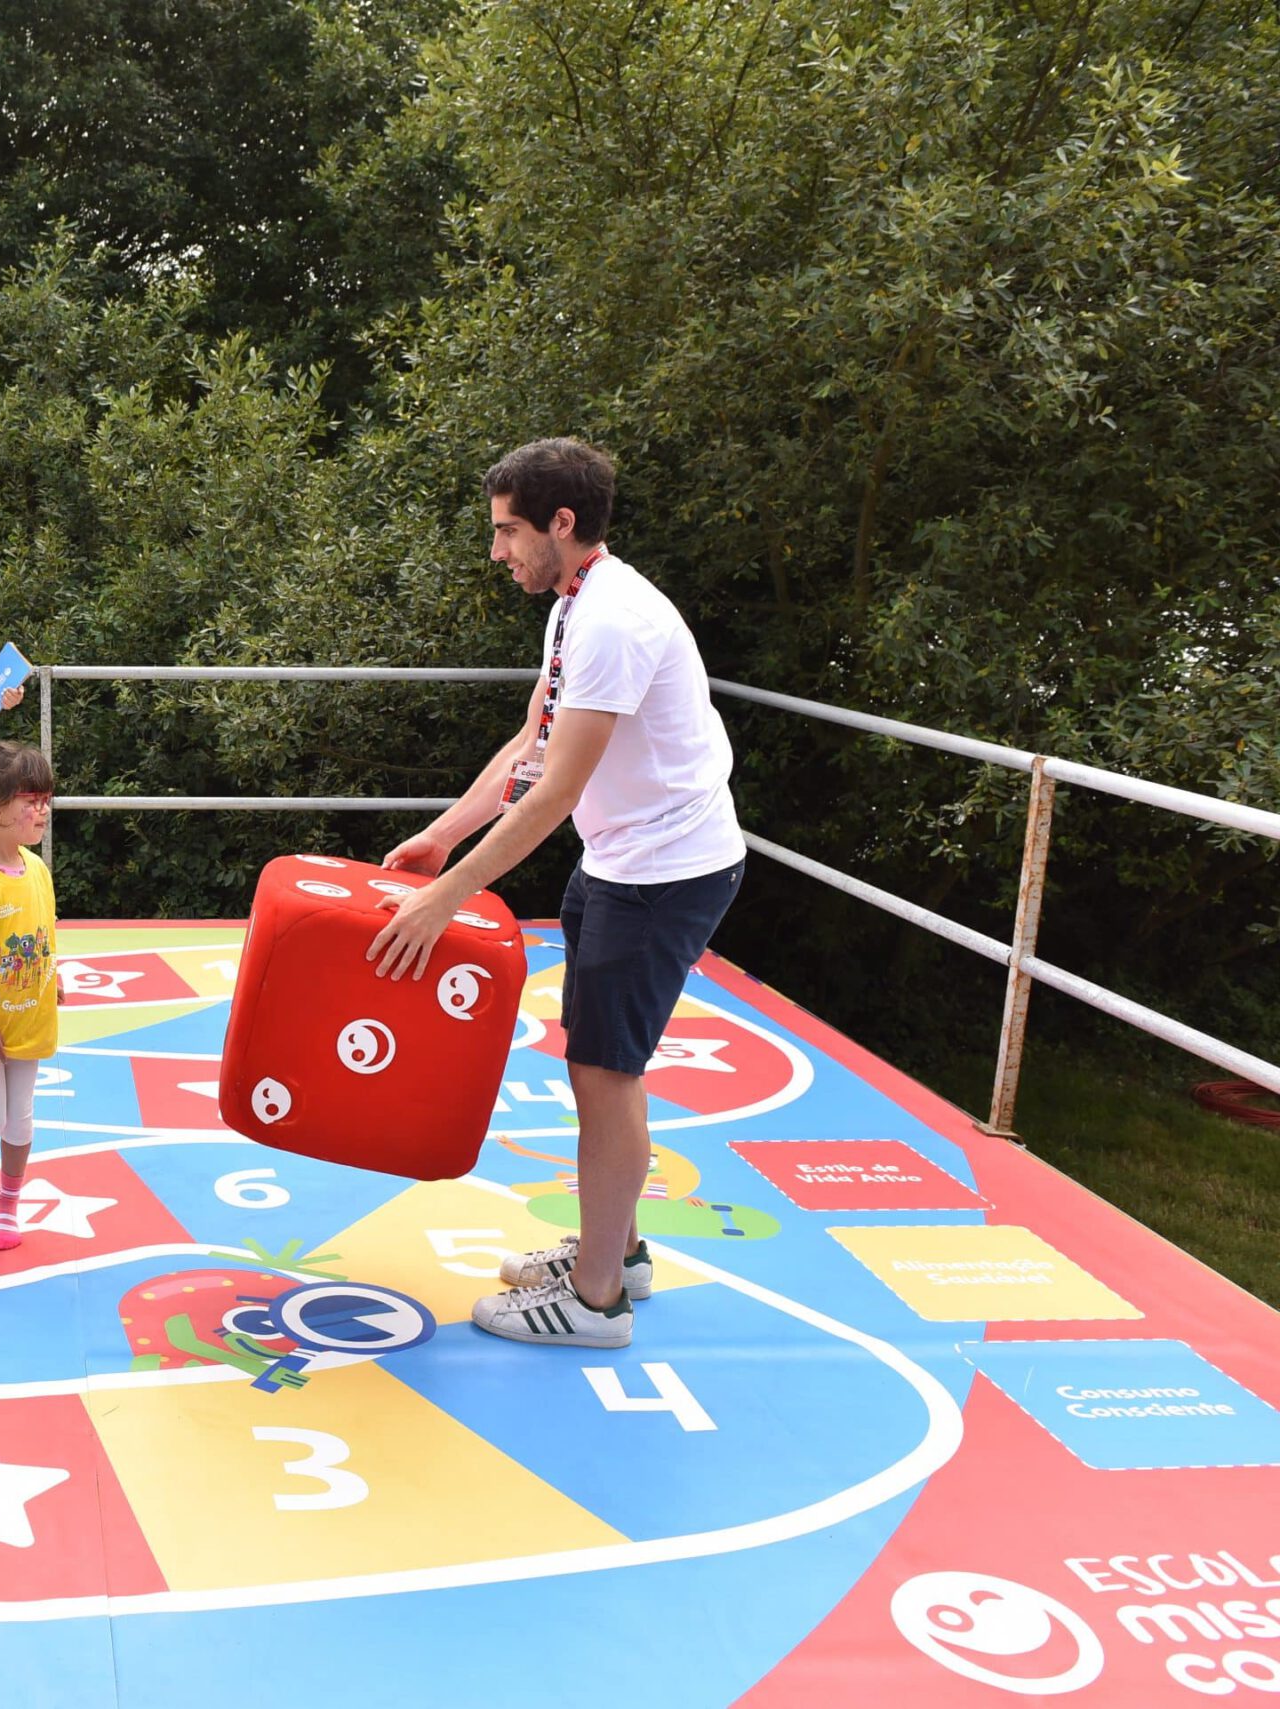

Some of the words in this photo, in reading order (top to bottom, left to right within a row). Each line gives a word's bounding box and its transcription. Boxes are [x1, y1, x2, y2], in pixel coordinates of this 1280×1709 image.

[795, 1173, 855, 1183] Vida
[860, 1173, 923, 1183] Ativo
[796, 1163, 864, 1173] Estilo
[871, 1163, 900, 1173] de
[214, 1168, 290, 1209] 6
[18, 1199, 61, 1223] 7
[424, 1228, 506, 1277] 5
[891, 1258, 1056, 1273] Alimentação
[926, 1272, 1055, 1286] Saudável
[581, 1362, 718, 1431] 4
[1056, 1385, 1201, 1400] Consumo
[1066, 1402, 1237, 1419] Consciente
[251, 1425, 369, 1510] 3
[1063, 1550, 1280, 1596] ESCOL
